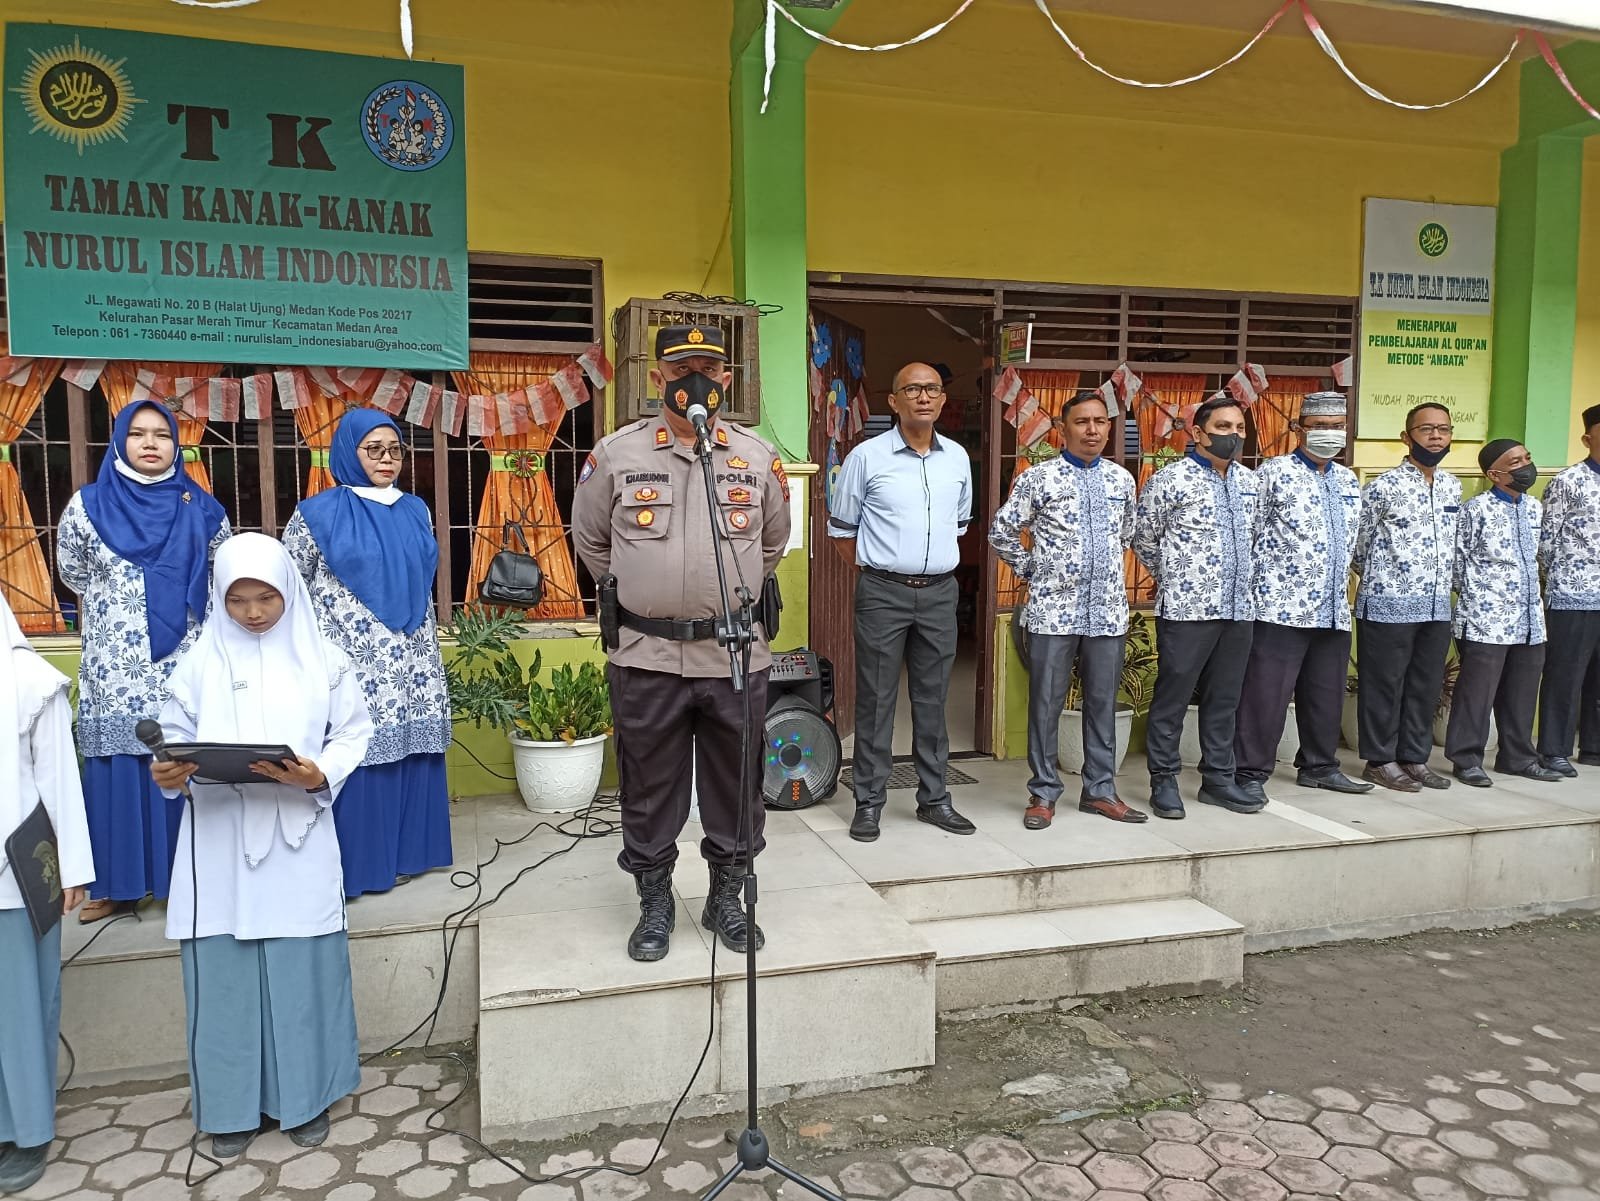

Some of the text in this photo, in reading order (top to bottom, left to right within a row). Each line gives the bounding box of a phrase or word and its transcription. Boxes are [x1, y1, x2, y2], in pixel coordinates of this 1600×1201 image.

[166, 104, 336, 171] T K
[44, 174, 433, 237] TAMAN KANAK-KANAK
[23, 230, 454, 291] NURUL ISLAM INDONESIA
[1387, 273, 1415, 299] NURUL
[1417, 275, 1444, 300] ISLAM
[1446, 276, 1489, 303] INDONESIA
[84, 294, 412, 321] JL. Megawati No. 20 B (Halat Ujung) Medan Kode Pos 20217
[98, 311, 399, 335] Kelurahan Pasar Merah Timur Kecamatan Medan Area
[1397, 319, 1457, 333] MENERAPKAN
[52, 325, 99, 339] Telepon
[110, 328, 130, 339] 061
[141, 329, 187, 341] 7360440
[190, 331, 224, 342] e-mail
[234, 333, 443, 352] nurulislam_indonesiabaru@yahoo.com
[1369, 335, 1487, 351] PEMBELAJARAN AL QUR'AN
[1388, 353, 1424, 366] METODE
[716, 473, 757, 487] POLRI
